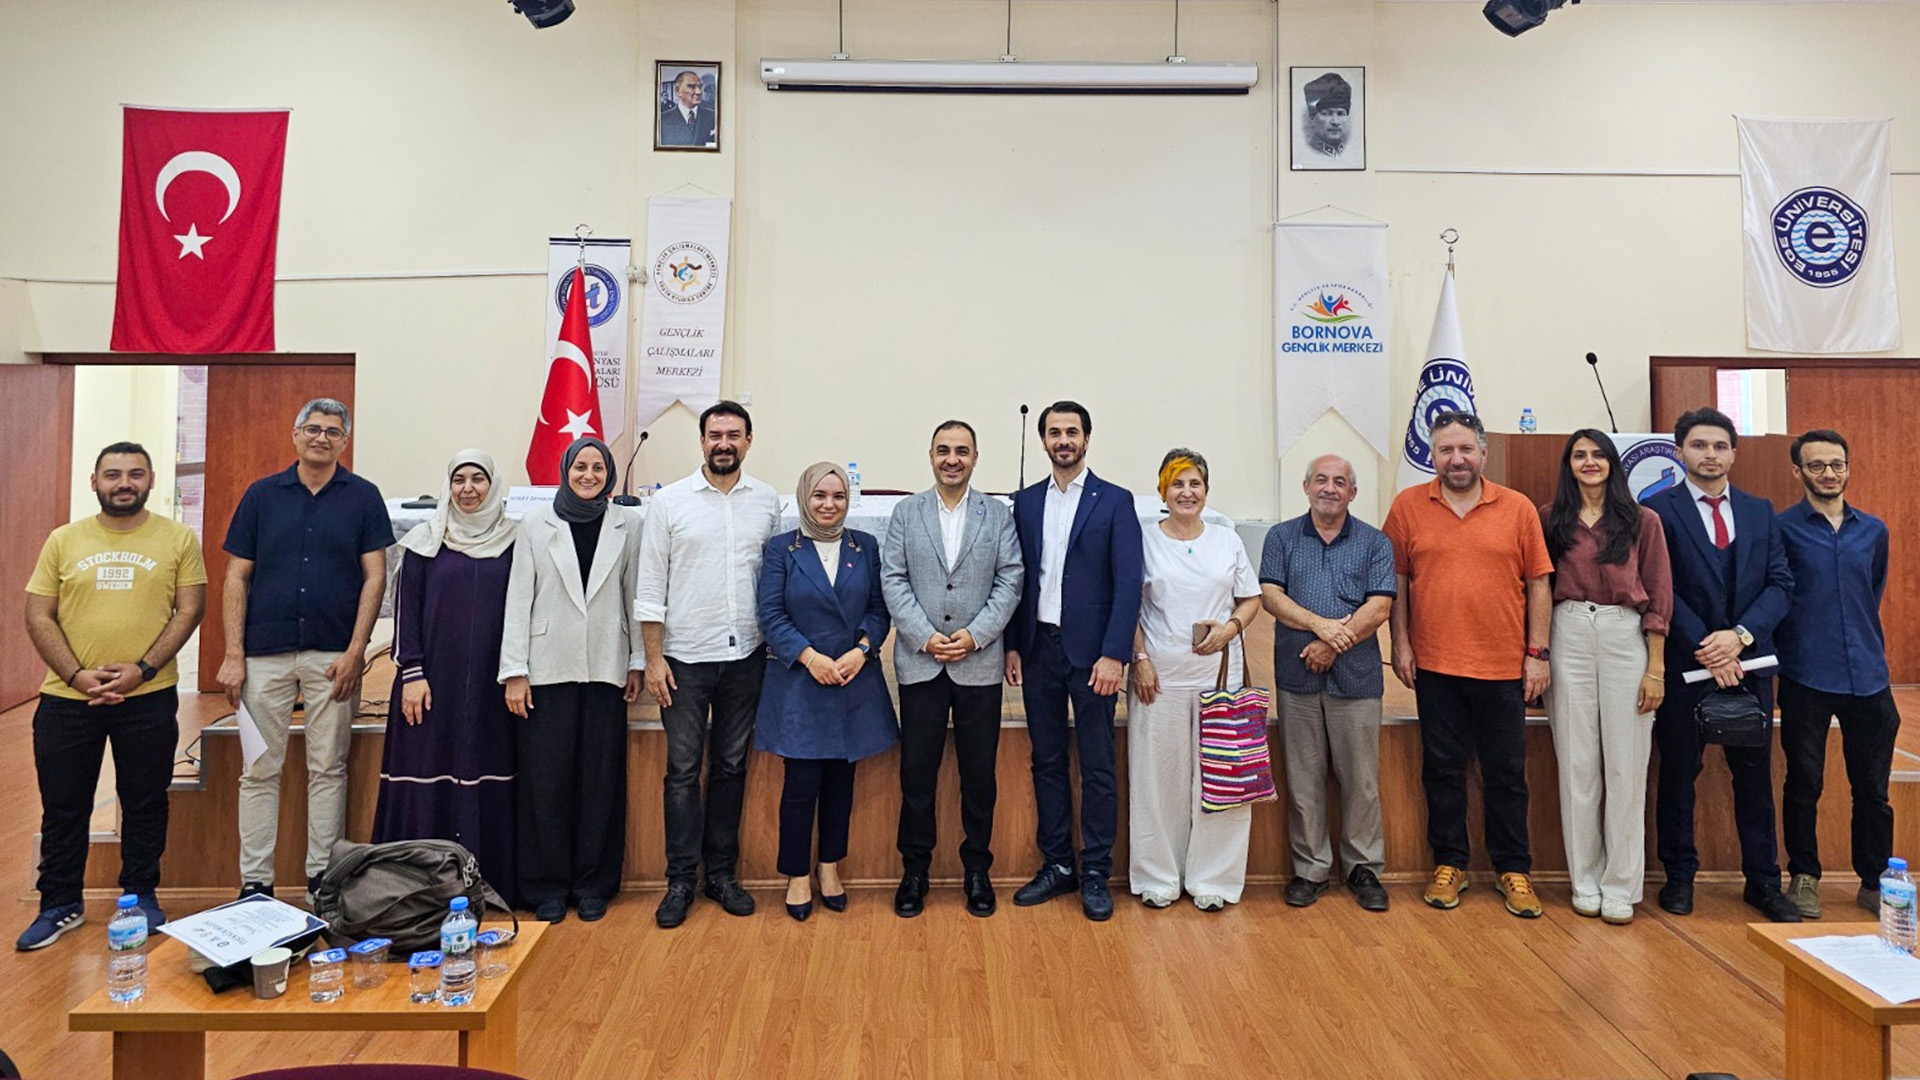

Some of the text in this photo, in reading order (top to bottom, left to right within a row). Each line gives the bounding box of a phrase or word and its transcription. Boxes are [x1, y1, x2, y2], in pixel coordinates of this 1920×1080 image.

[1778, 236, 1806, 273] EGE
[1807, 268, 1839, 278] 1955
[659, 327, 705, 338] GENÇLİK
[1292, 325, 1373, 339] BORNOVA
[647, 347, 715, 357] ÇALIŞMALARI
[1281, 341, 1383, 354] GENÇLİK MERKEZİ
[594, 357, 620, 366] NYASI
[656, 365, 704, 377] MERKEZİ
[1639, 445, 1676, 457] ARAŞTIR
[77, 551, 157, 571] STOCKHOLM
[102, 569, 129, 579] 1992
[96, 581, 133, 590] SWEDEN
